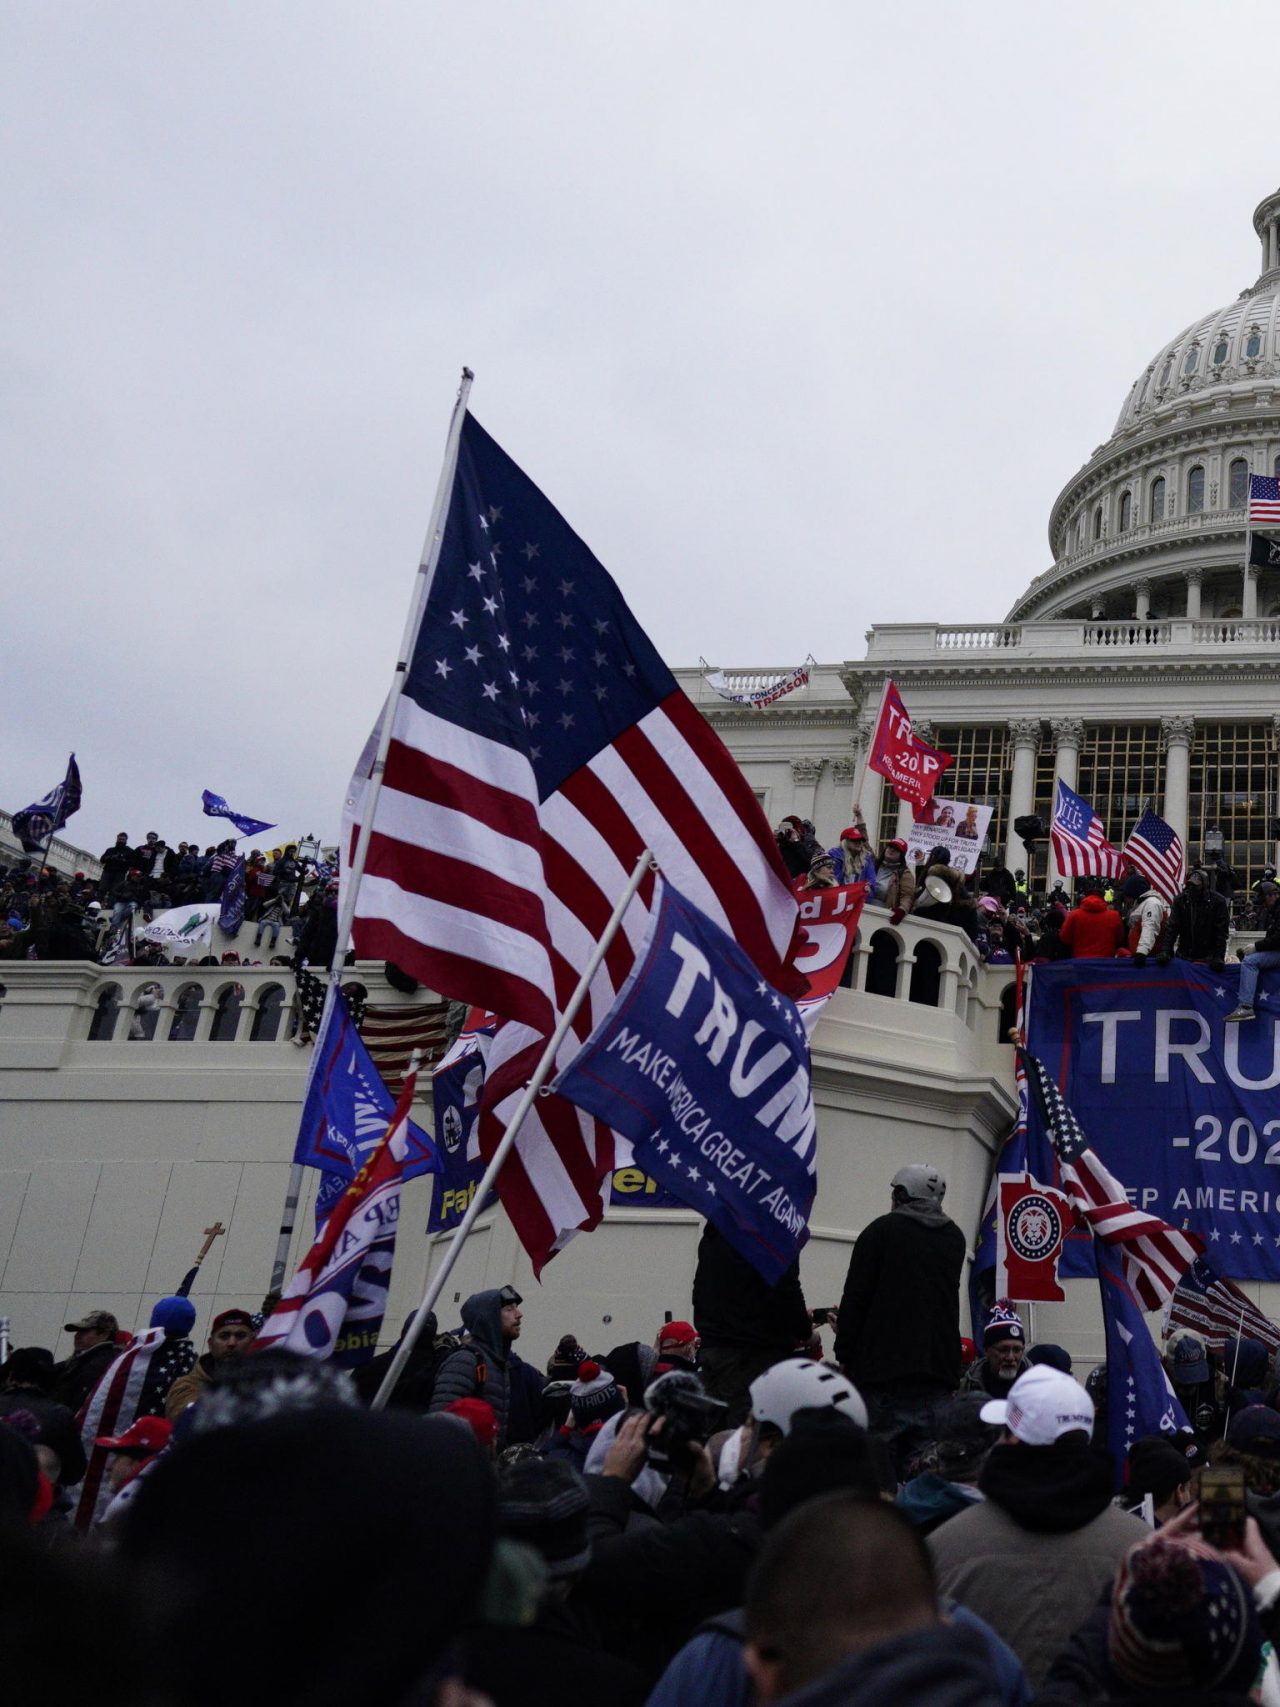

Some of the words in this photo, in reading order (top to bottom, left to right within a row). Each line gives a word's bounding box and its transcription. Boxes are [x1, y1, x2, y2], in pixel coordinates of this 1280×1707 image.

[750, 679, 787, 700] CONCEDE
[793, 667, 803, 678] TO
[754, 671, 809, 710] TREASON
[831, 891, 855, 916] J.
[664, 931, 817, 1176] TRUM
[606, 1027, 677, 1089] MAKE
[665, 1070, 708, 1144] AMERICA
[700, 1129, 772, 1196] GREAT
